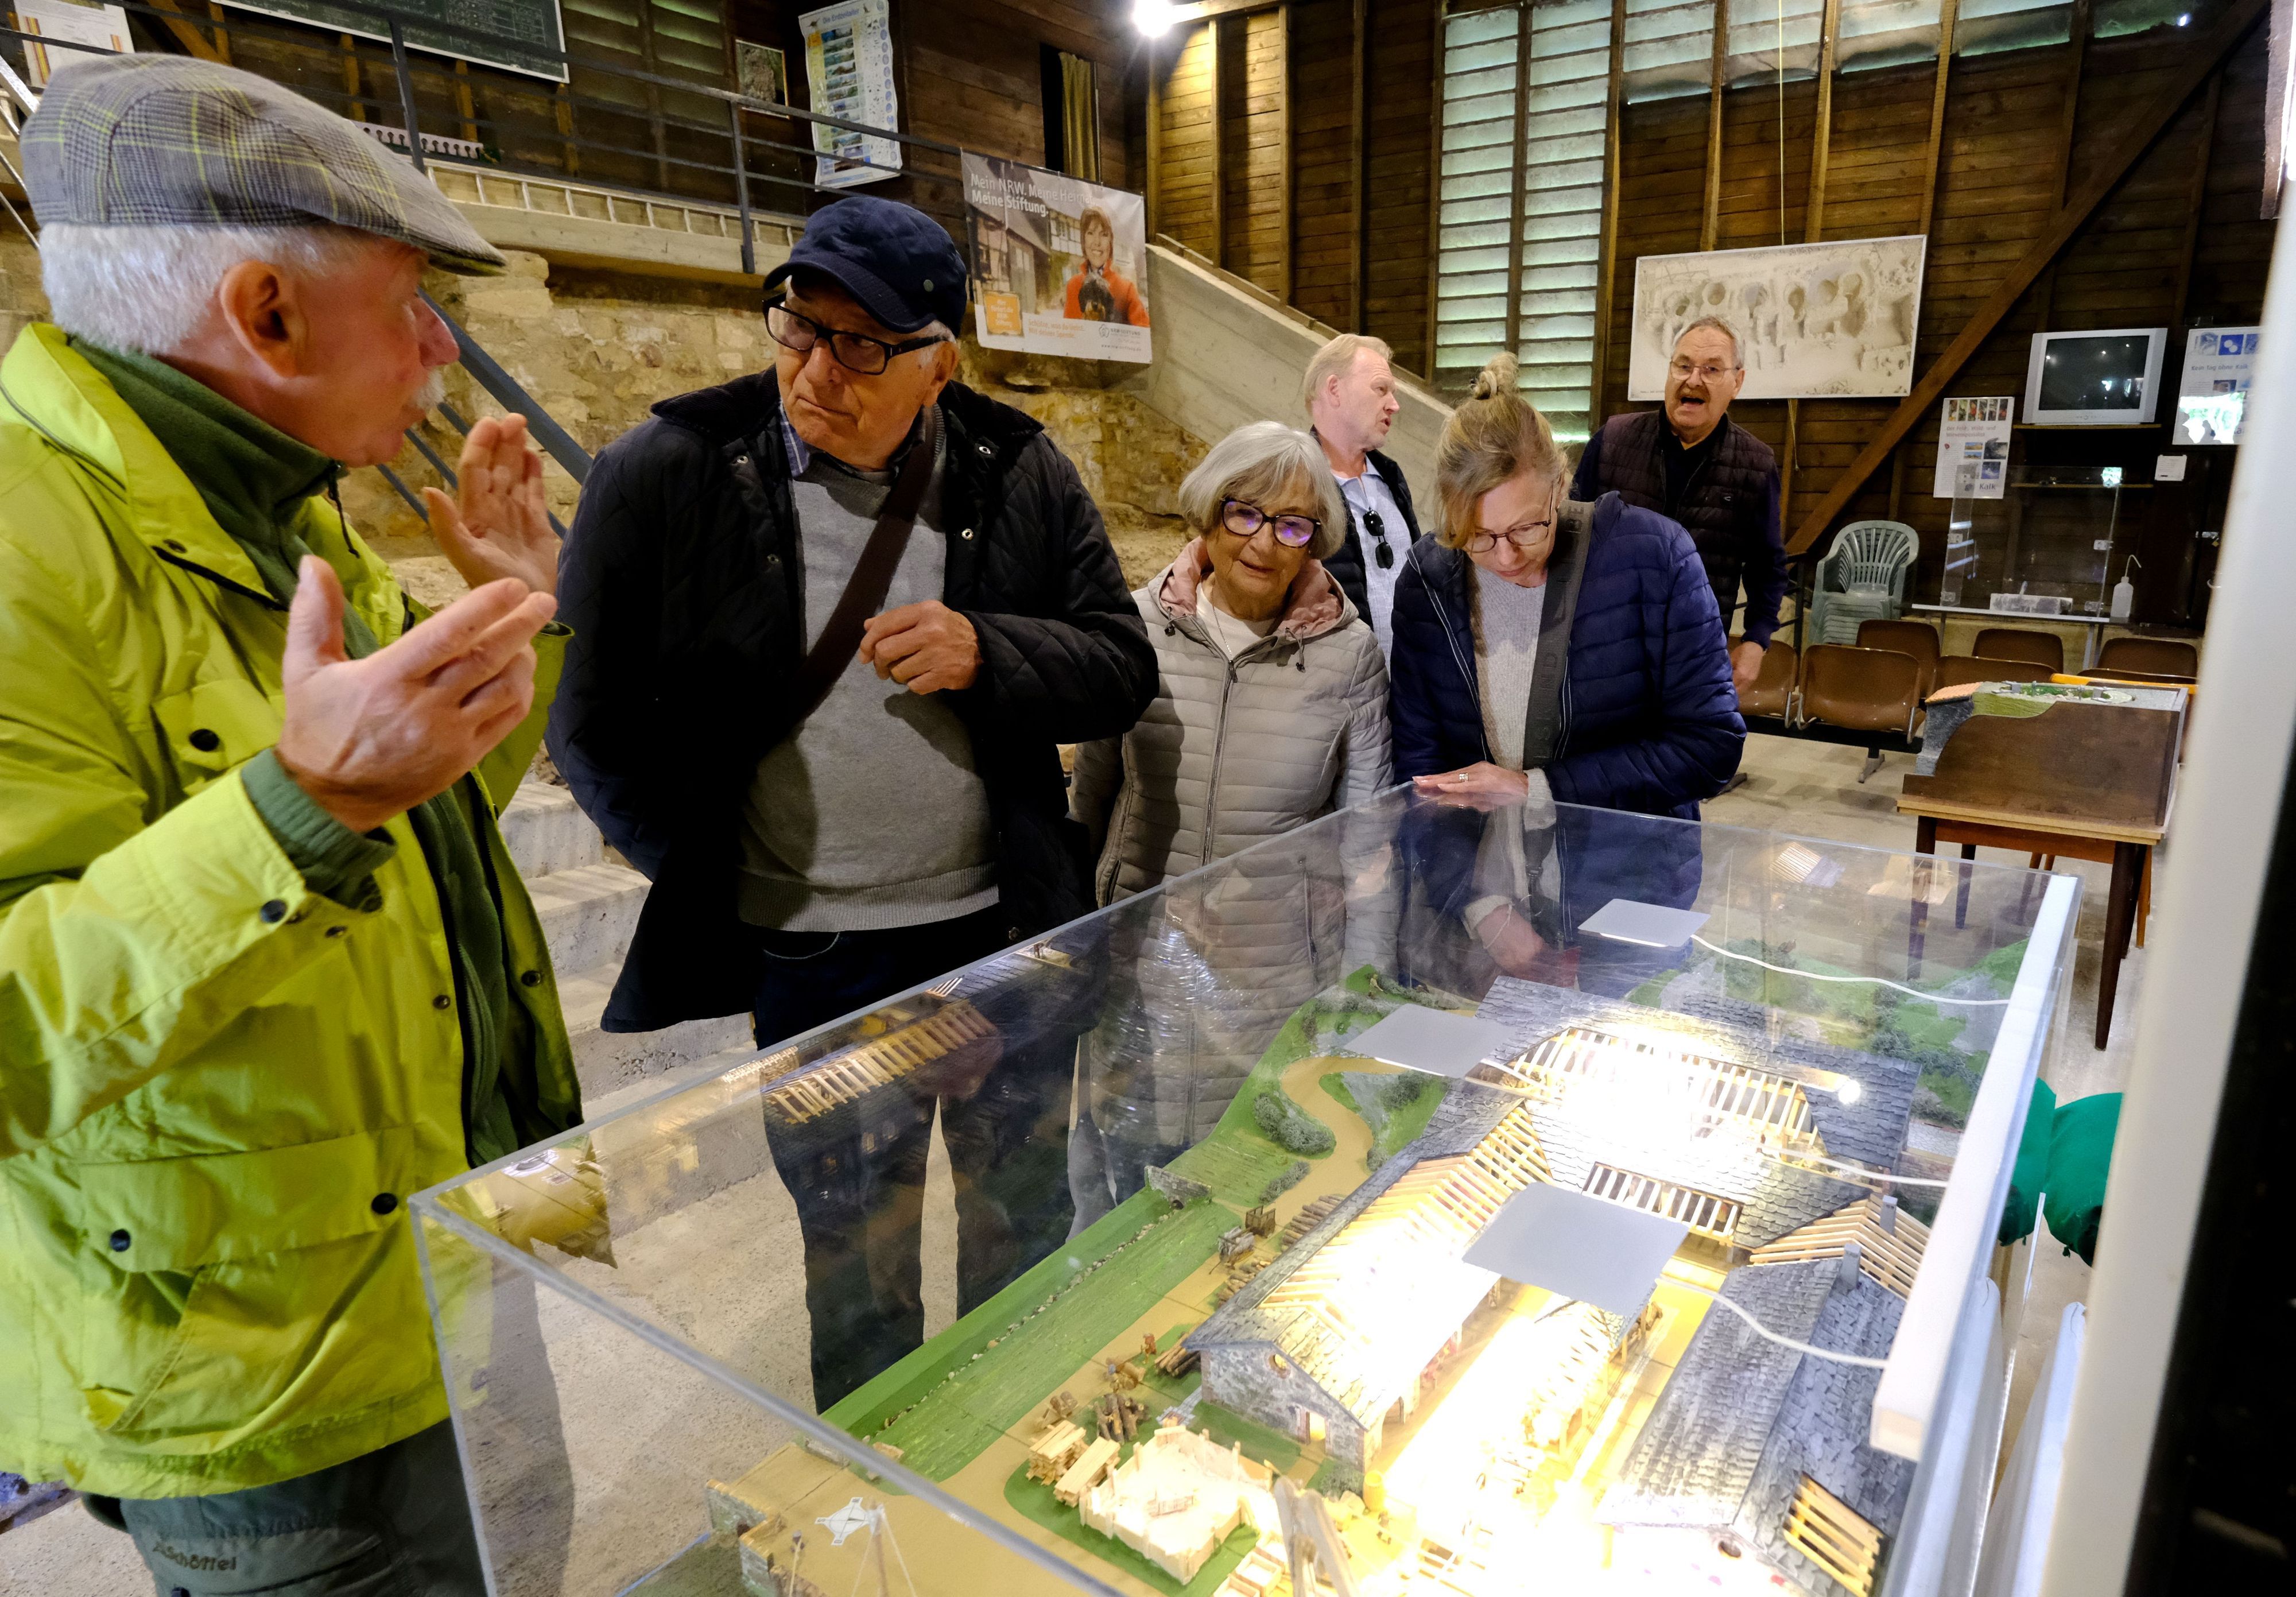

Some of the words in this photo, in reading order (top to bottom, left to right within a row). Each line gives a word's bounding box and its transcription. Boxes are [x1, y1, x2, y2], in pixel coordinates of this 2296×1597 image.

[971, 173, 995, 190] Mein
[999, 178, 1027, 196] NRW.
[1029, 184, 1060, 200] Meine
[972, 189, 1004, 207] Meine
[1005, 196, 1049, 217] Stiftung.
[161, 1546, 236, 1571] Schöffel
